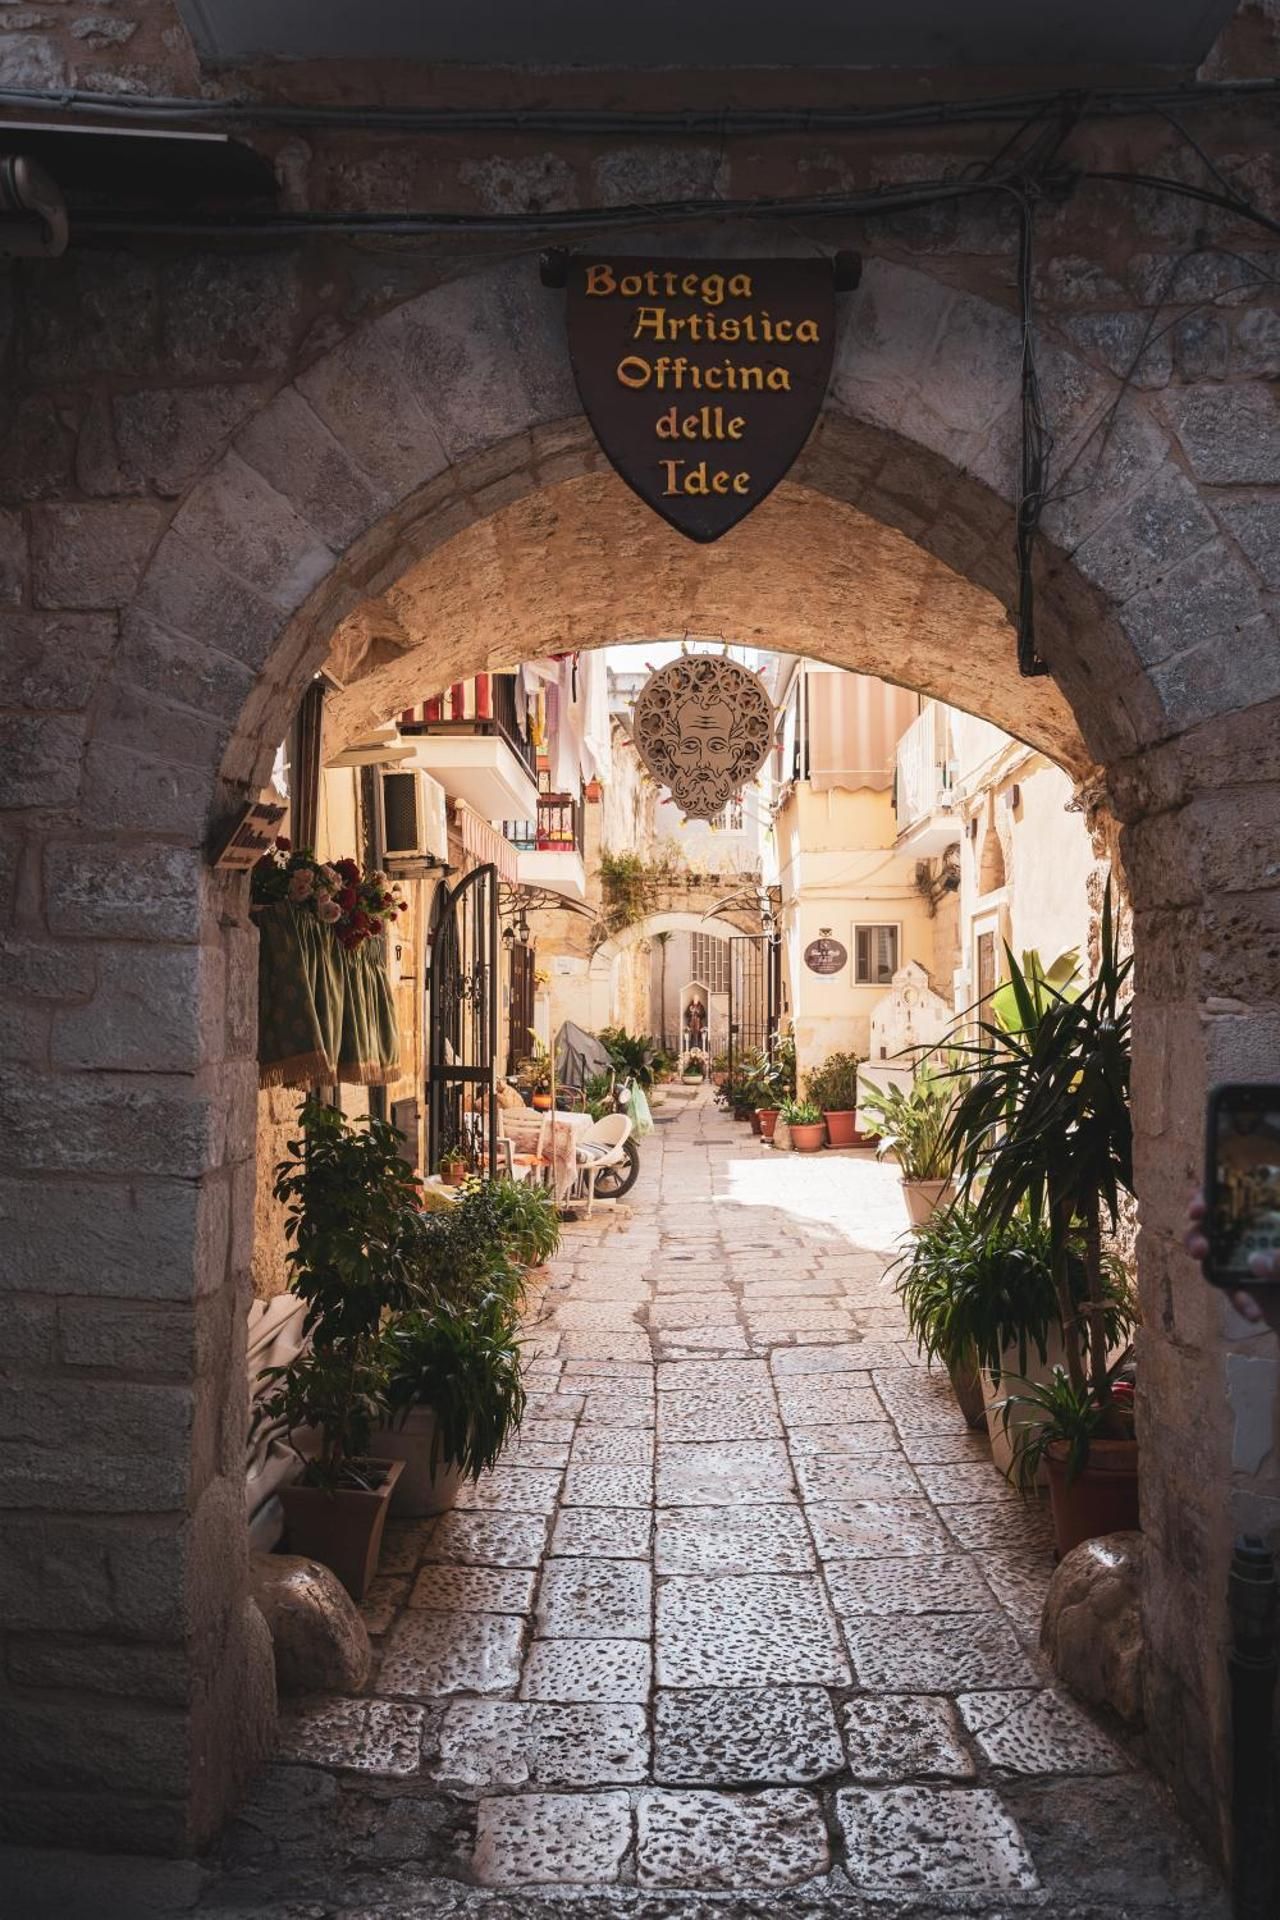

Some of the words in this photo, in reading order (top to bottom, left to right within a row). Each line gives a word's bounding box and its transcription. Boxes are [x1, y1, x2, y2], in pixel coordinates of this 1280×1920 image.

[585, 264, 753, 305] Bottega
[634, 306, 820, 342] Artistica
[617, 355, 791, 391] Officina
[655, 406, 747, 440] delle
[659, 459, 751, 496] Idee
